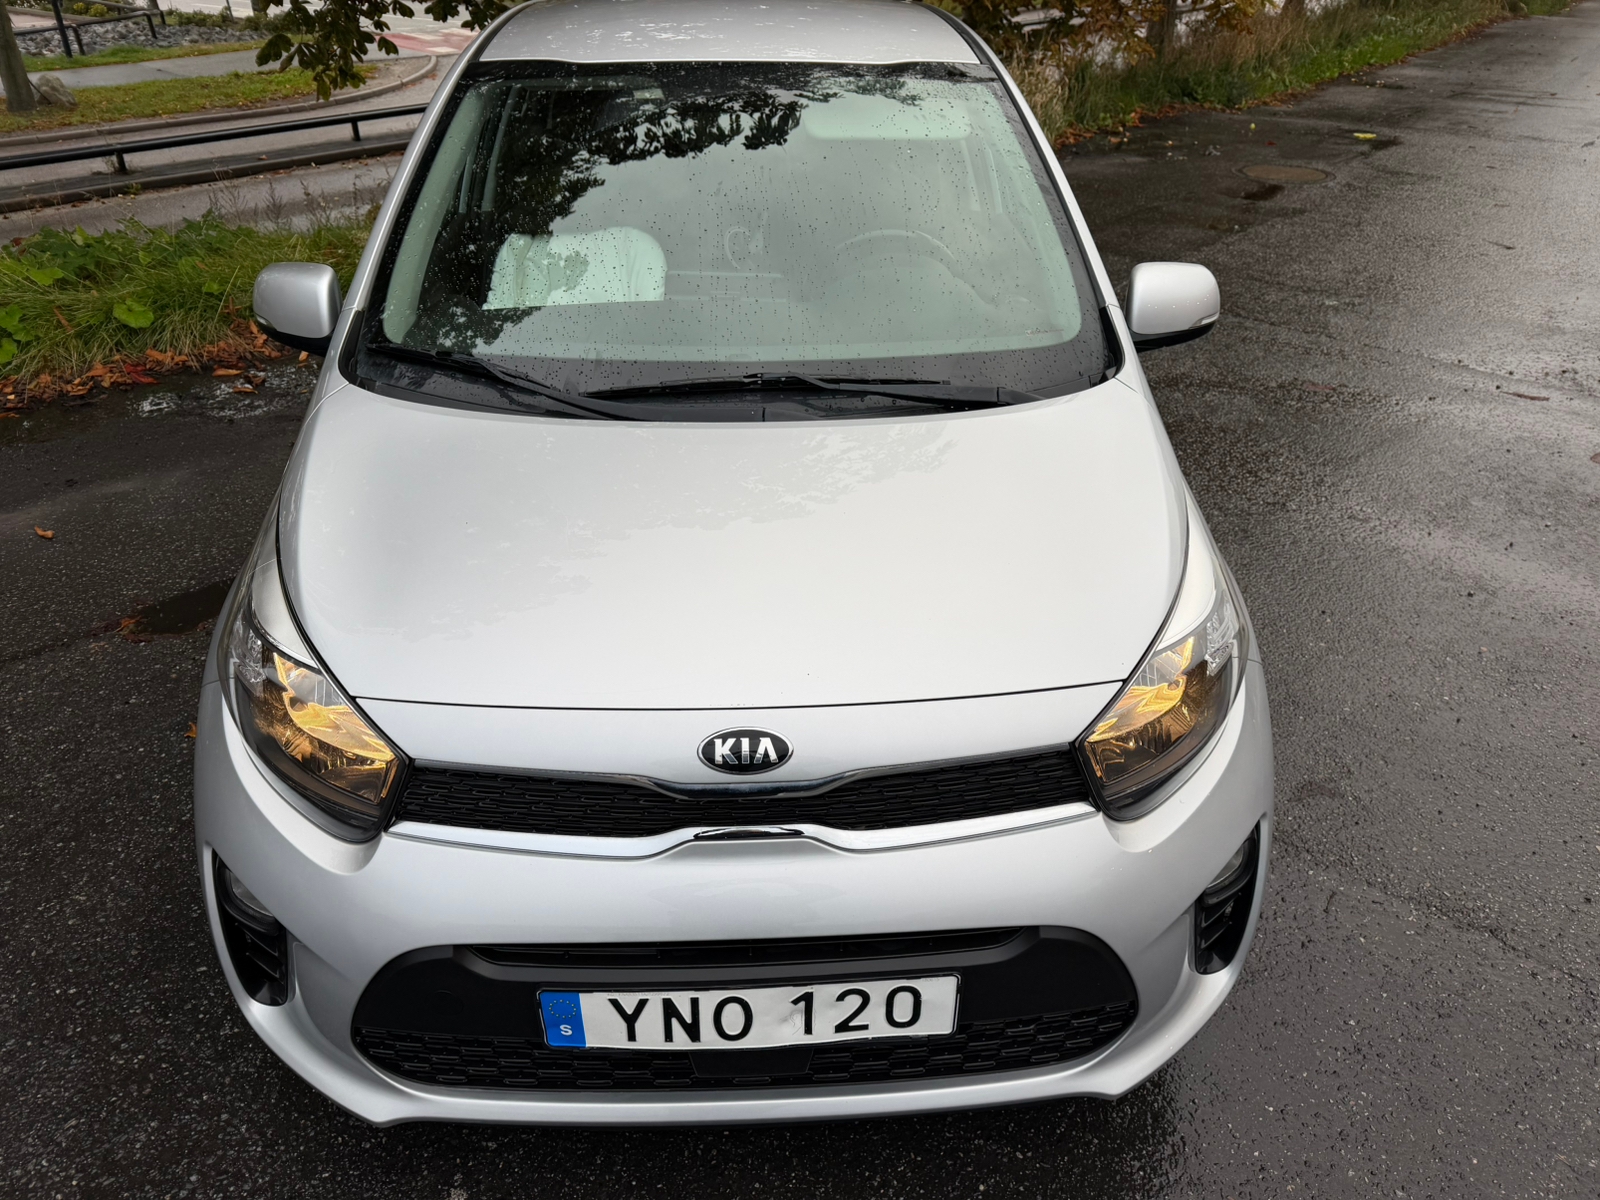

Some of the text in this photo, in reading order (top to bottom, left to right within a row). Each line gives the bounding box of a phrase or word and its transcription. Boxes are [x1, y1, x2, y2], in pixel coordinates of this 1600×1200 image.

[713, 737, 779, 764] KIA
[607, 985, 922, 1043] YNO 120
[559, 1024, 573, 1036] S
